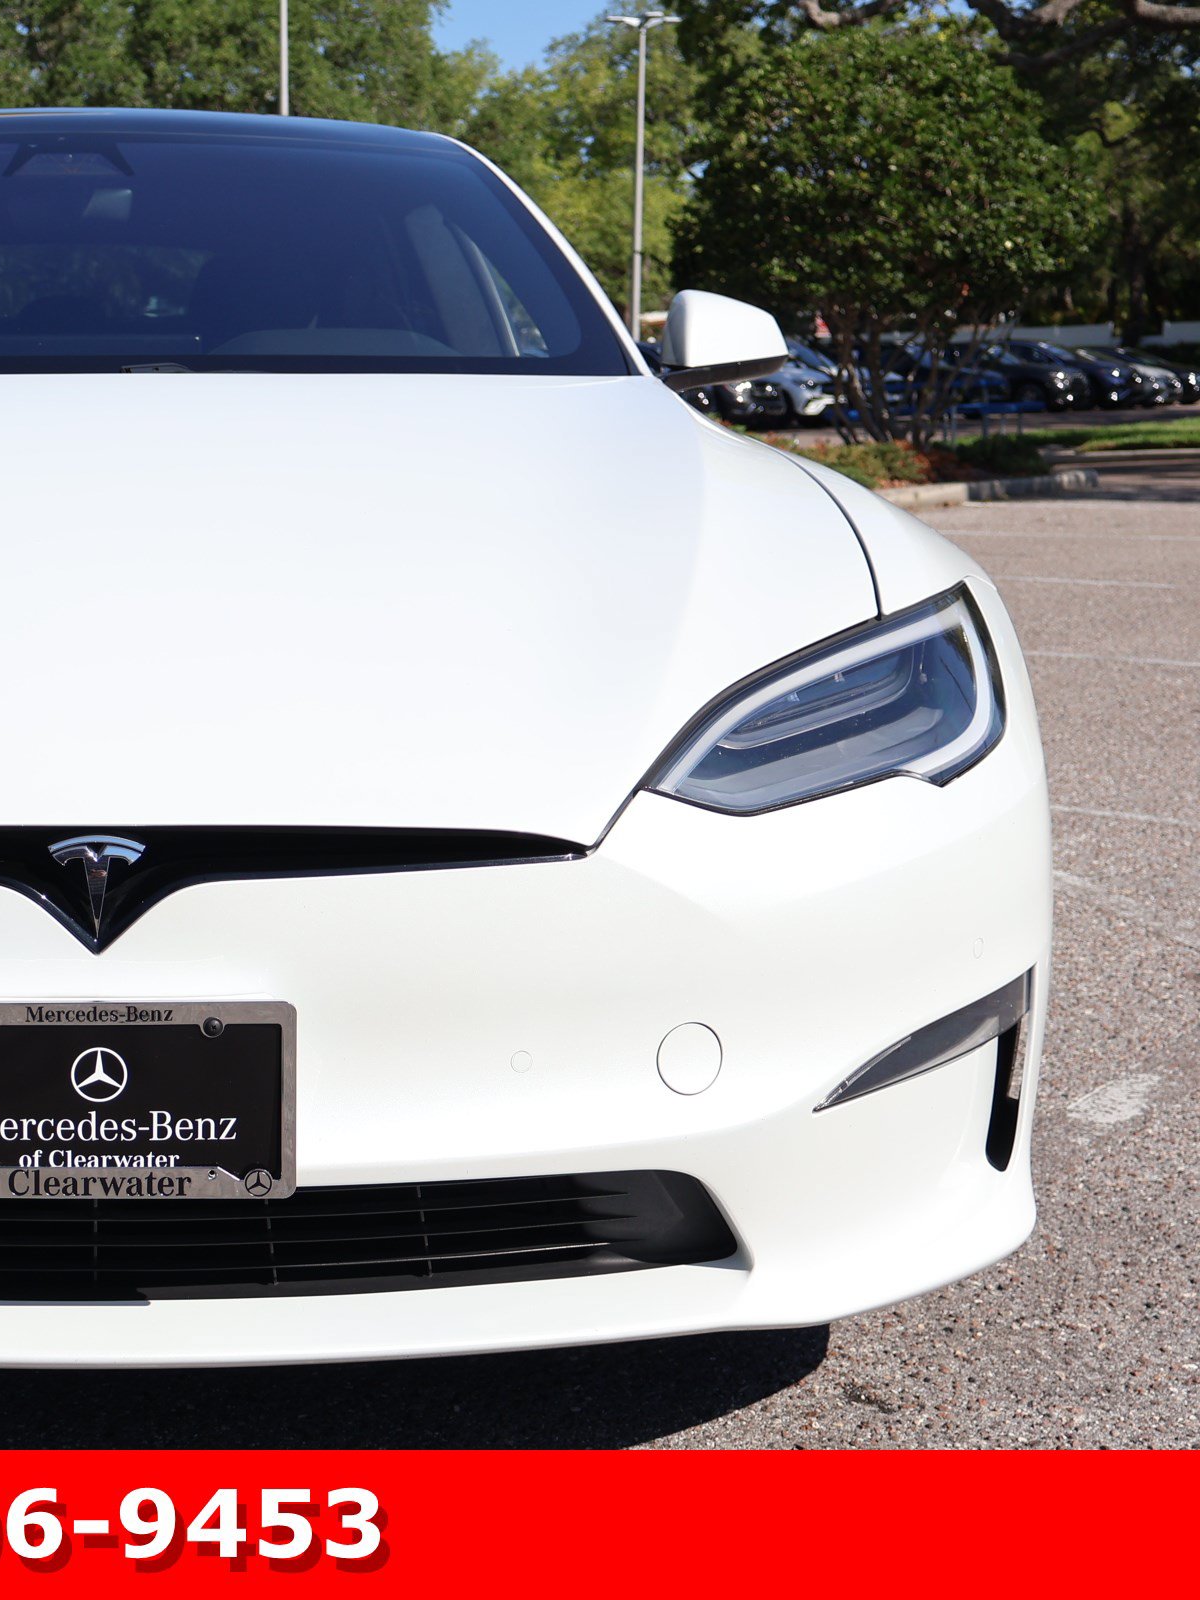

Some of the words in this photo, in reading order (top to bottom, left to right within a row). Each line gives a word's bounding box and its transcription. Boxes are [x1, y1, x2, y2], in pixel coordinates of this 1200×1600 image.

[25, 1005, 174, 1023] Mercedes-Benz
[18, 1149, 43, 1168] of
[48, 1149, 180, 1168] Clearwater
[7, 1168, 192, 1197] Clearwater
